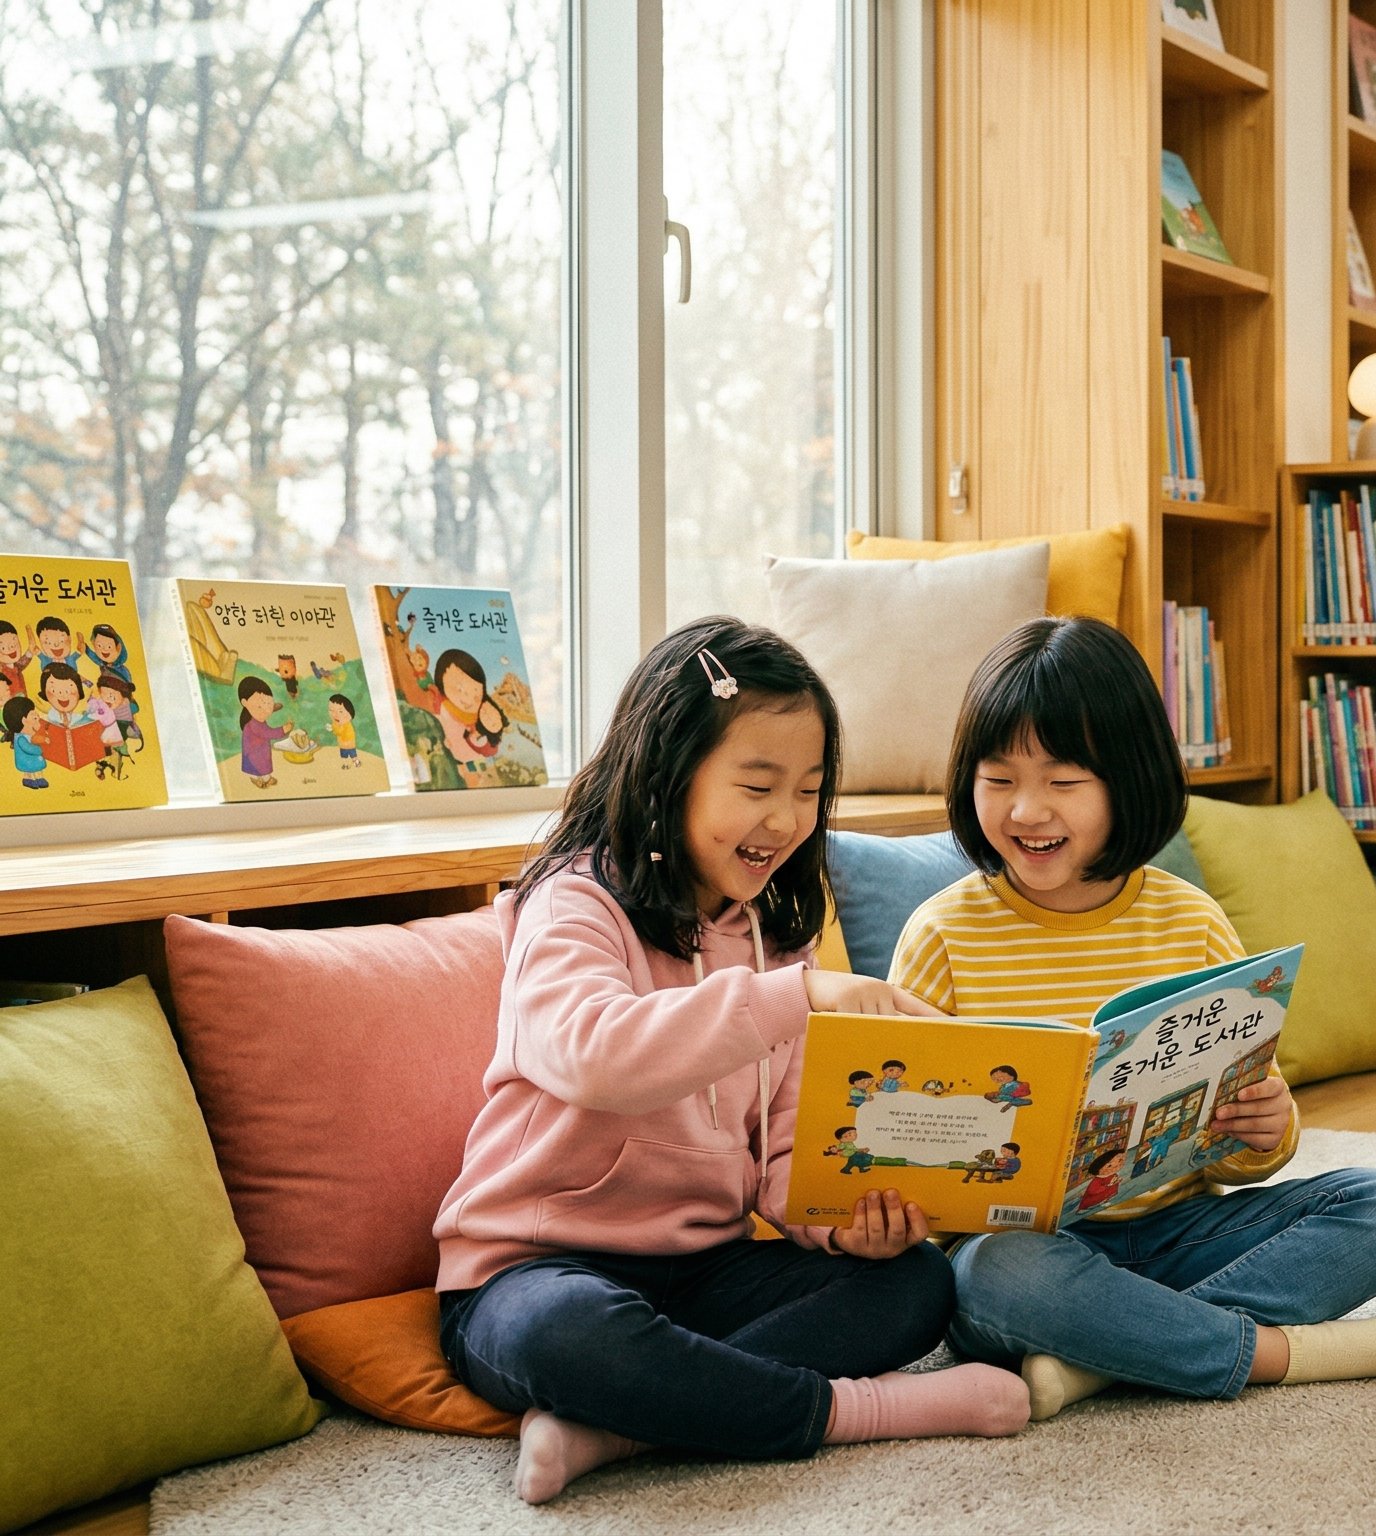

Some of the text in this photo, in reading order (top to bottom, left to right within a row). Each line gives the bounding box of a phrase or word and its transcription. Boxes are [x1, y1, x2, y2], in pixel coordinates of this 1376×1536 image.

[58, 578, 117, 606] 도서관
[422, 607, 508, 634] 즐거운 도서관
[1155, 997, 1228, 1046] 즐거운
[1108, 1042, 1183, 1092] 즐거운
[1188, 1010, 1264, 1058] 도서관
